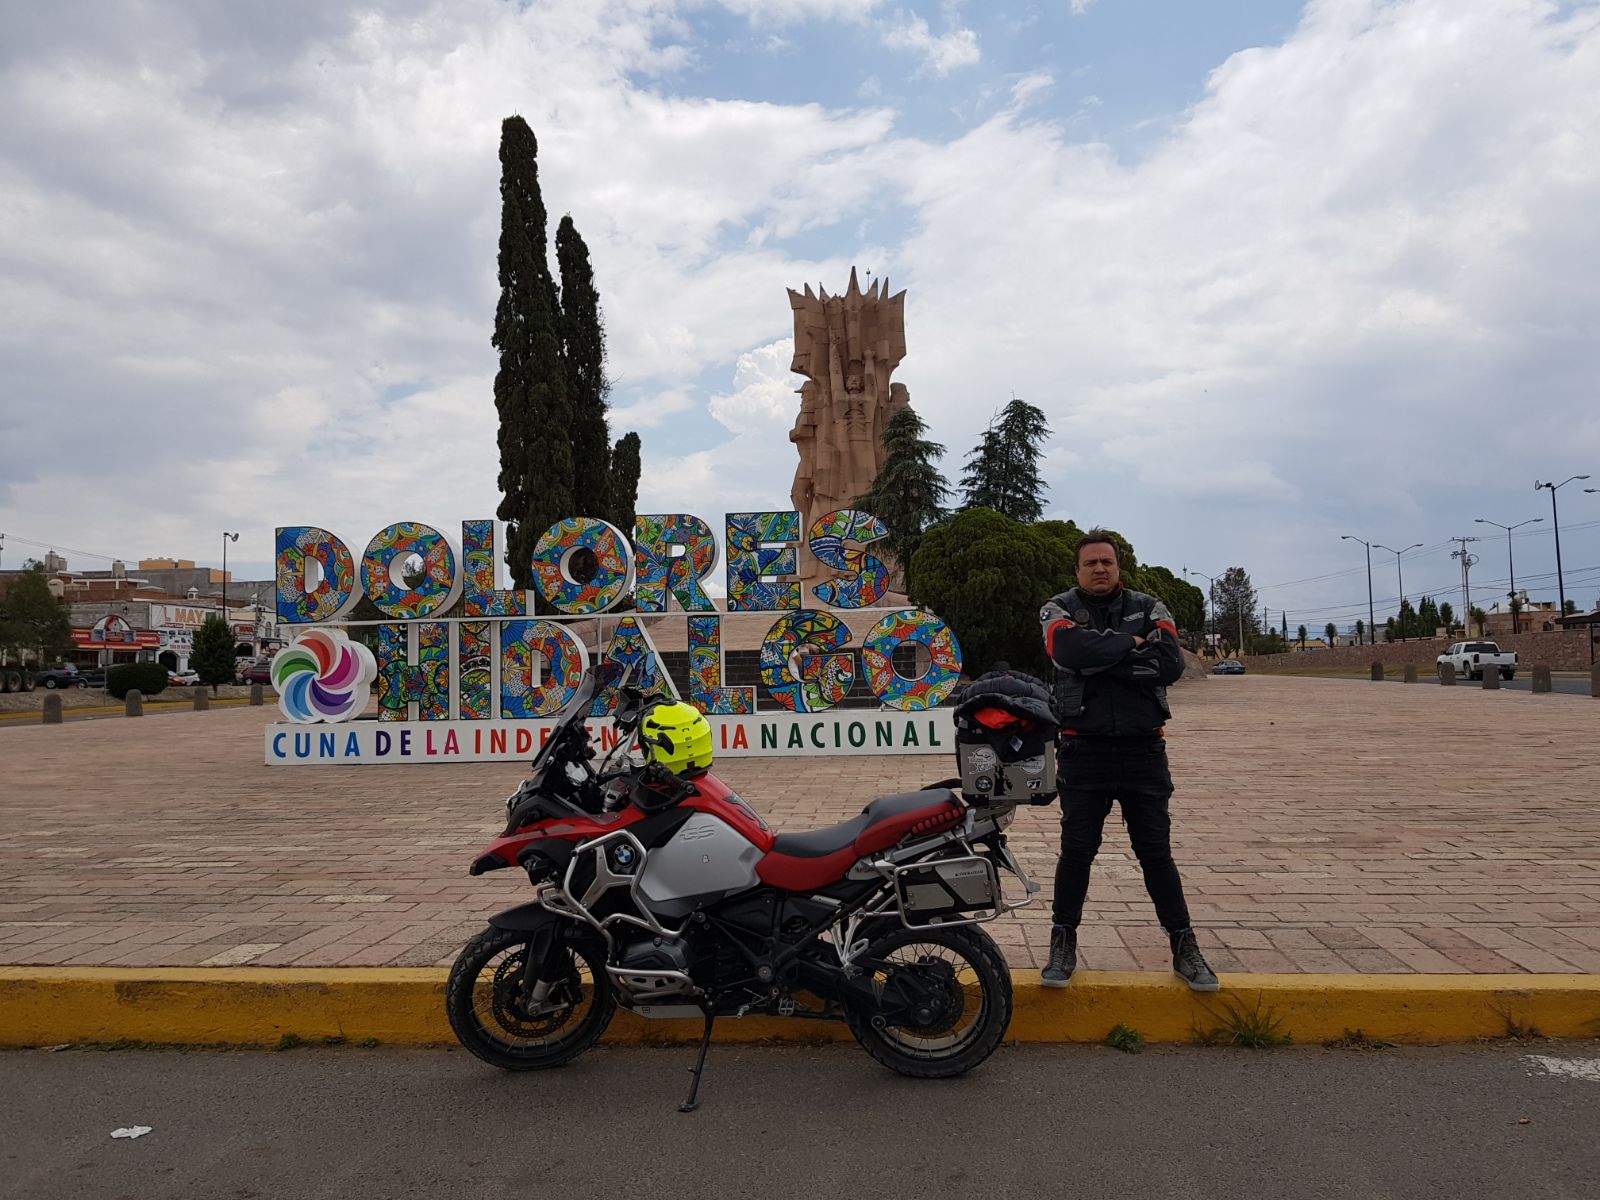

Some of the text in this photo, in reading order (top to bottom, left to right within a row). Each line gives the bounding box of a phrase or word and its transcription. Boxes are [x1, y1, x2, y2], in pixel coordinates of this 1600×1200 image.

[275, 508, 890, 624] DOLORES
[378, 608, 963, 721] HIDALGO
[272, 731, 360, 758] CUNA
[376, 730, 411, 756] DE
[426, 729, 464, 755] LA
[761, 720, 941, 750] NACIONAL
